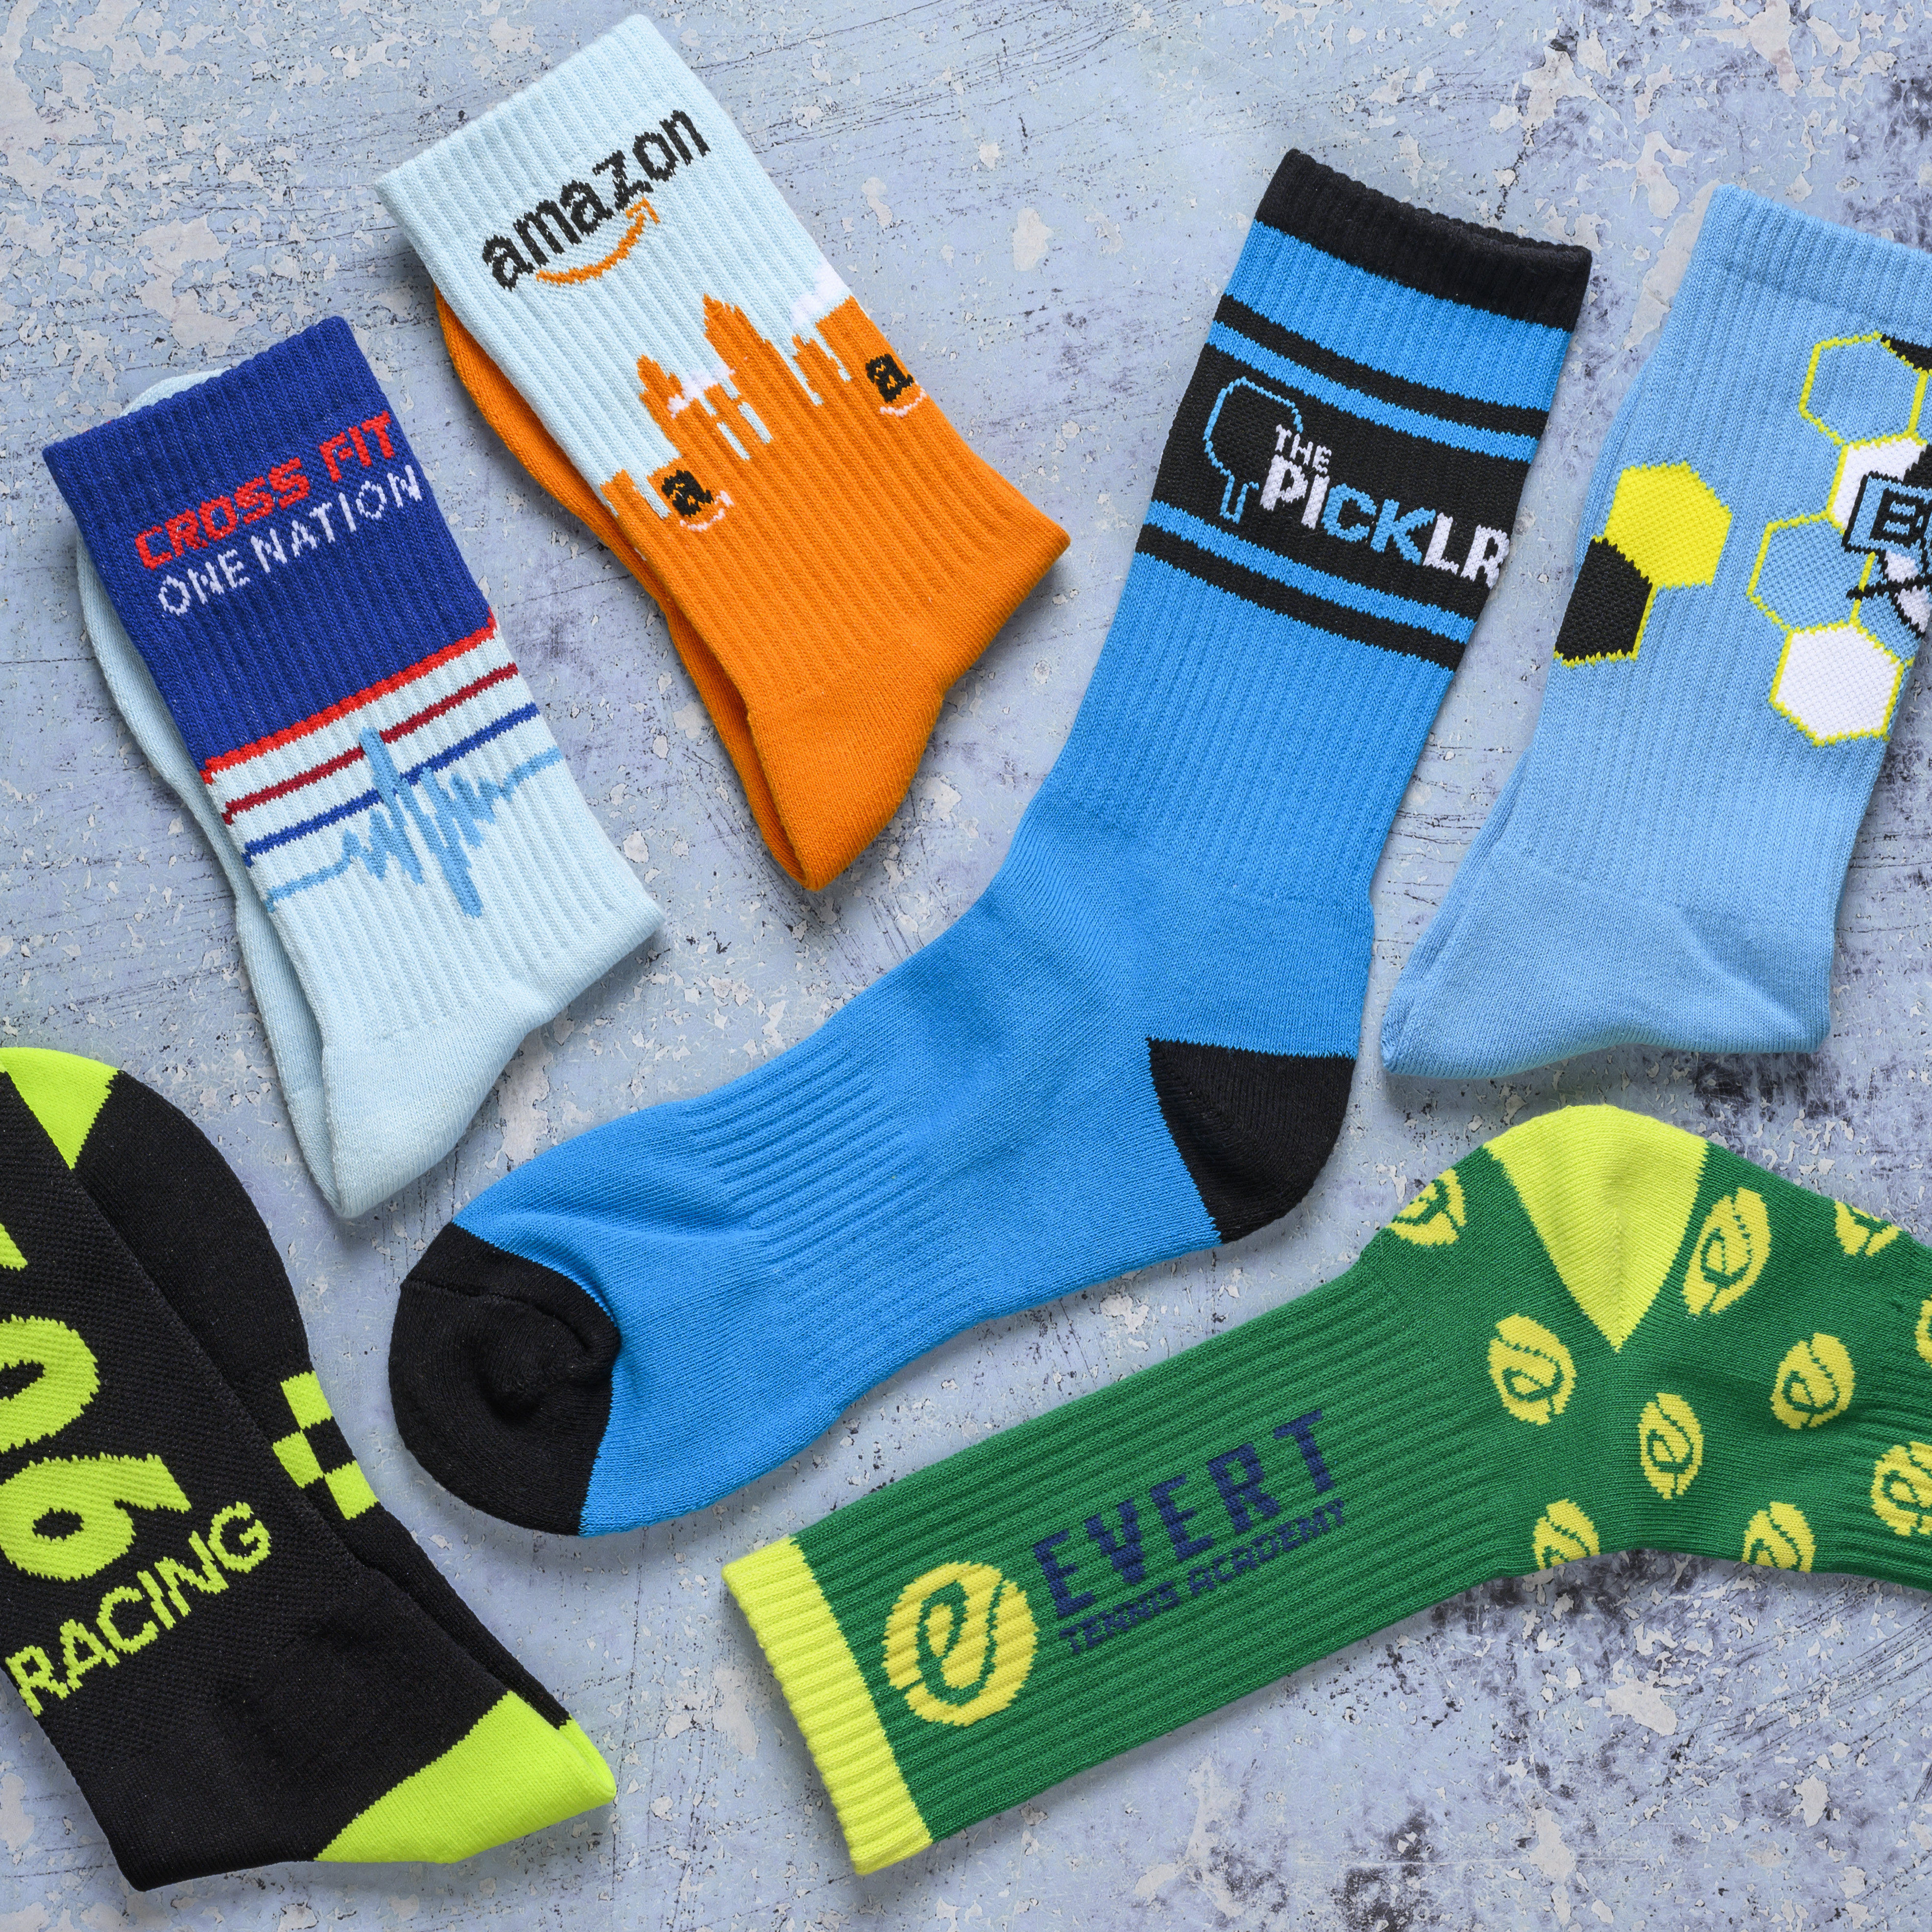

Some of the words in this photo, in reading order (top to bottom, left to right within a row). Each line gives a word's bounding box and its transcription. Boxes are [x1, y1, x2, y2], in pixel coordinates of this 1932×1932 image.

[482, 110, 710, 291] amazon
[135, 458, 310, 570] CROSS
[319, 411, 395, 482] FIT
[1259, 454, 1510, 588] PICKLR
[1275, 424, 1332, 474] THE
[157, 549, 250, 616] ONE
[250, 464, 422, 573] NATION
[1033, 1409, 1334, 1618] EVERT
[1060, 1581, 1180, 1654] TENNIS
[1188, 1497, 1344, 1595] ACADEMY
[5, 1502, 271, 1716] RACING
